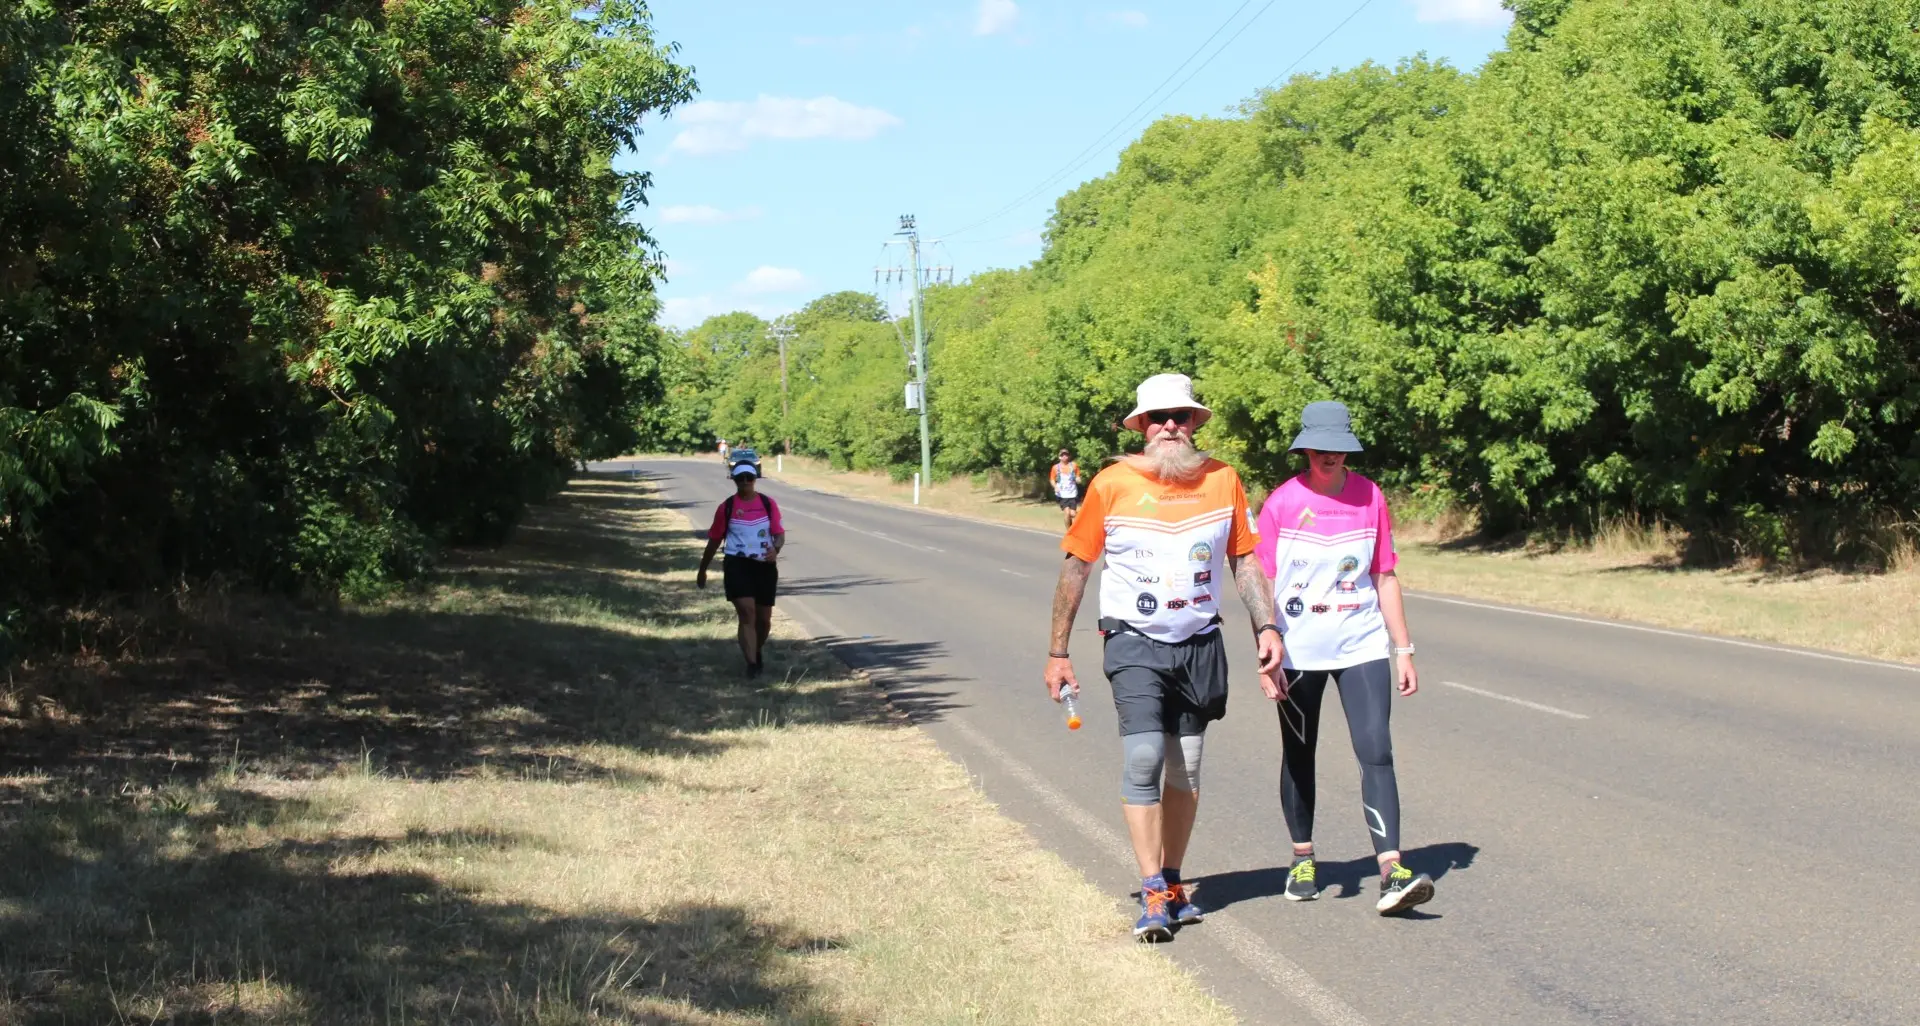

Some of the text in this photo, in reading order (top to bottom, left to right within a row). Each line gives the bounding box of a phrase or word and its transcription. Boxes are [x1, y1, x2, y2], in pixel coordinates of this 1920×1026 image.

[1135, 549, 1153, 559] ECS
[1167, 600, 1188, 609] BSF
[1312, 605, 1331, 613] BSF
